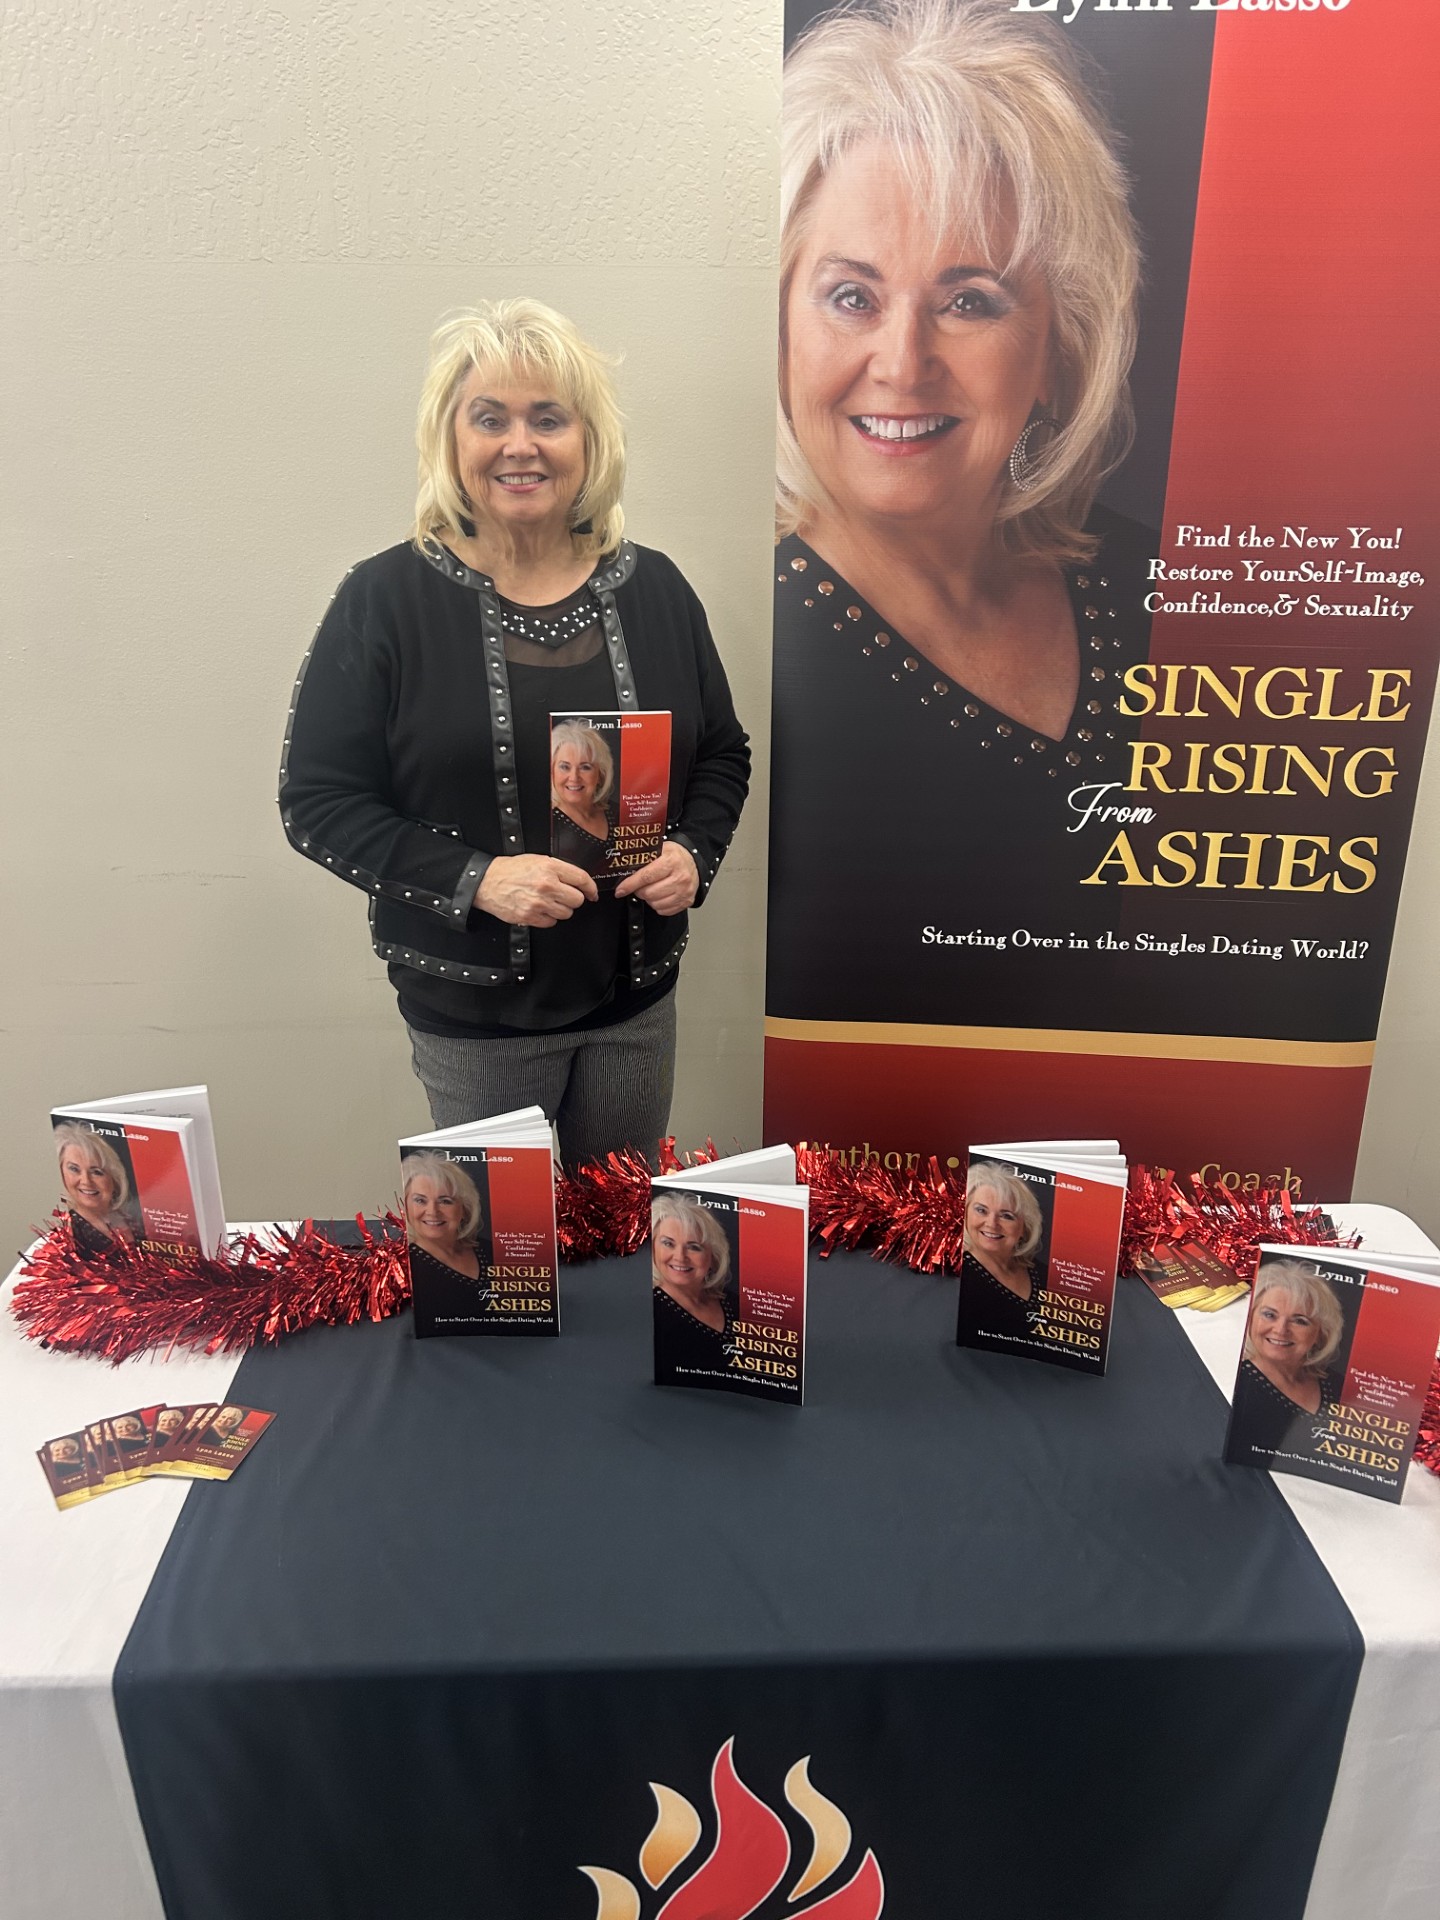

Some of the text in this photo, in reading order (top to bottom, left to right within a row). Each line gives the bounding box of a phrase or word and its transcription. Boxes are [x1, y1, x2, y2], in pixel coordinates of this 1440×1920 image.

[1175, 525, 1402, 550] Find the New You!
[1147, 559, 1233, 582] Restore
[1304, 595, 1414, 620] Sexuality
[1119, 664, 1412, 722] SINGLE
[588, 719, 642, 730] Lynn Lasso
[1122, 742, 1399, 798] RISING
[1067, 782, 1157, 833] From
[613, 823, 661, 837] SINGLE
[615, 836, 659, 850] RISING
[609, 851, 658, 868] ASHES
[1079, 830, 1378, 893] ASHES
[921, 926, 1369, 960] Starting Over in the Singles Dating World?
[90, 1123, 149, 1142] Lynn Lasso
[445, 1151, 514, 1164] Lynn Lasso
[1013, 1166, 1083, 1192] Lynn Lasso
[1200, 1163, 1303, 1196] Coach
[696, 1195, 766, 1217] Lynn Lasso
[141, 1240, 199, 1257] SINGLE
[487, 1265, 551, 1278] SINGLE
[1313, 1264, 1399, 1294] Lynn Lasso
[478, 1289, 499, 1300] From
[490, 1281, 551, 1292] RISING
[485, 1298, 552, 1311] ASHES
[1038, 1289, 1105, 1316] SINGLE
[1026, 1311, 1047, 1324] From
[1039, 1305, 1102, 1330] RISING
[732, 1320, 798, 1344] SINGLE
[1030, 1323, 1100, 1349] ASHES
[722, 1343, 743, 1356] From
[735, 1337, 798, 1358] RISING
[728, 1355, 797, 1379] ASHES
[1328, 1403, 1410, 1435] SINGLE
[1310, 1427, 1337, 1441] From
[1328, 1420, 1404, 1451] RISING
[1314, 1439, 1400, 1472] ASHES
